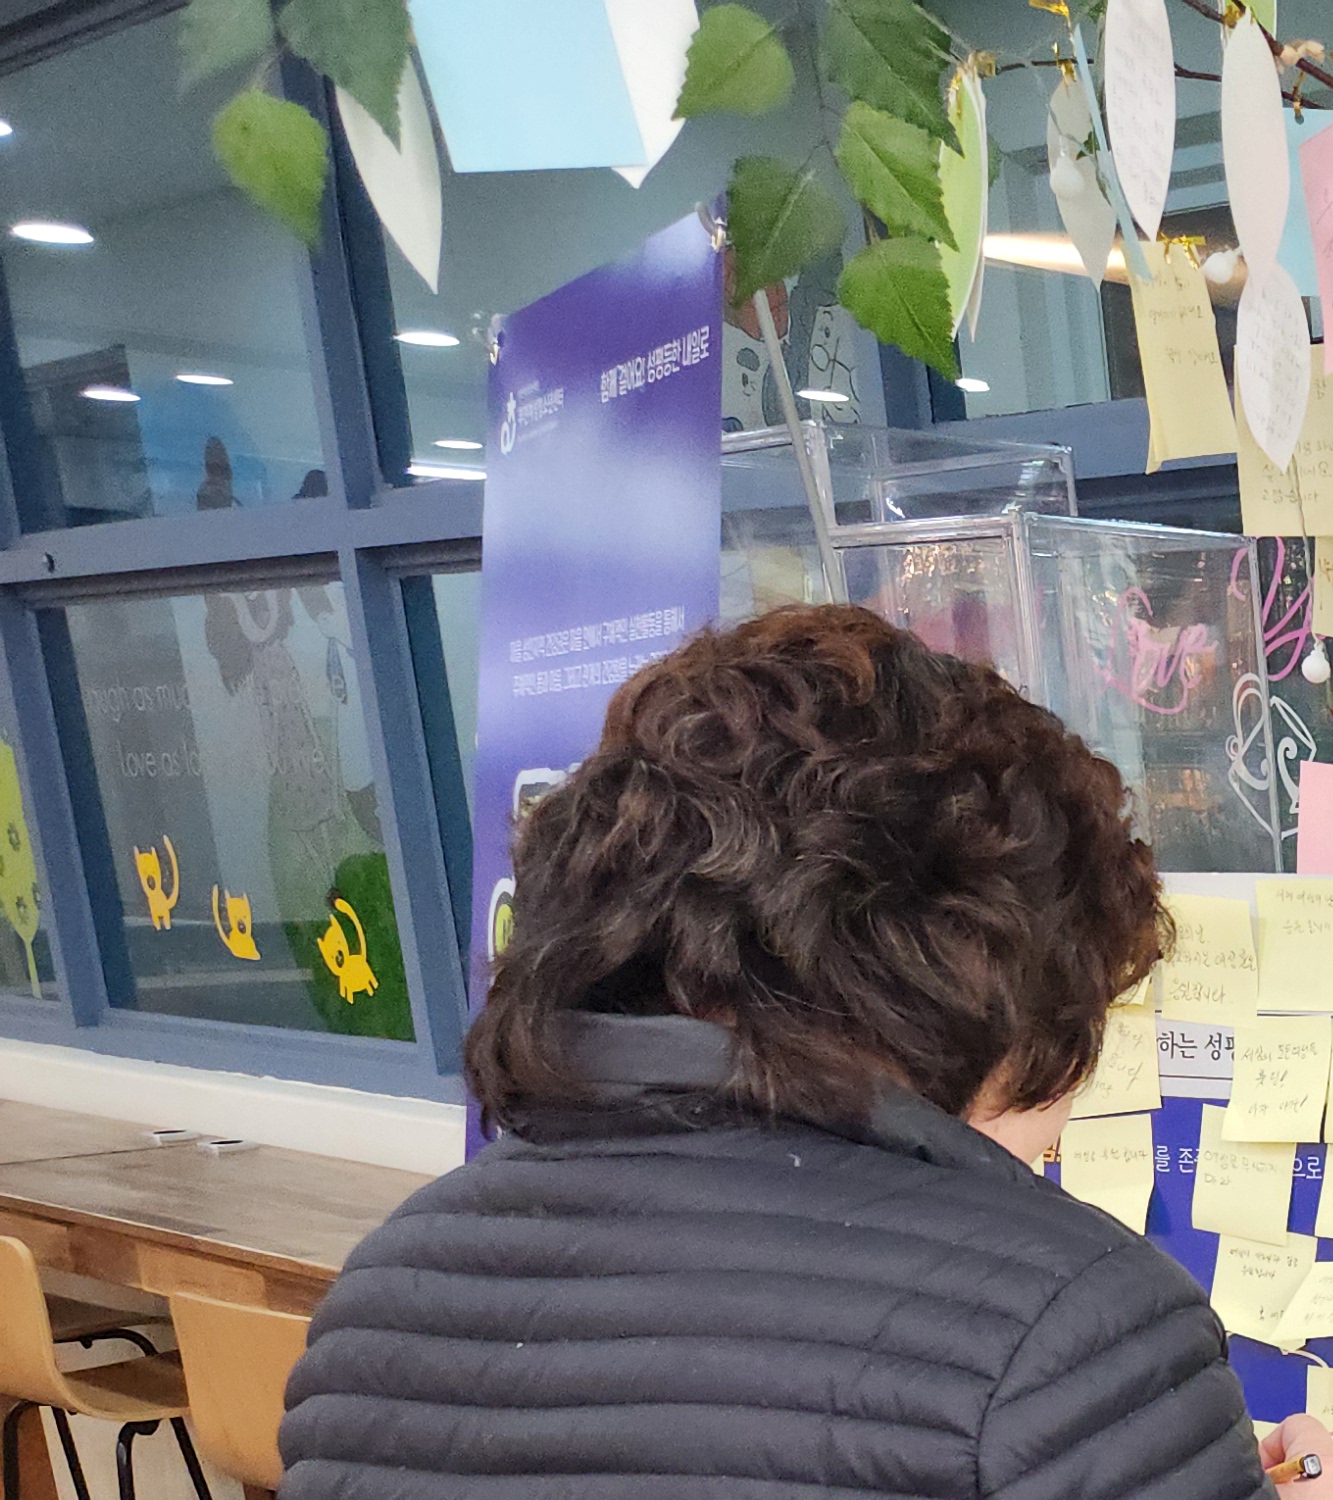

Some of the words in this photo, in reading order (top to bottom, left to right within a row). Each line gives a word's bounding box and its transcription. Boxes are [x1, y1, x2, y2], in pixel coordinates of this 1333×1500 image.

[601, 368, 617, 404] 함께
[647, 340, 680, 383] 성평등한
[683, 325, 710, 365] 내일로
